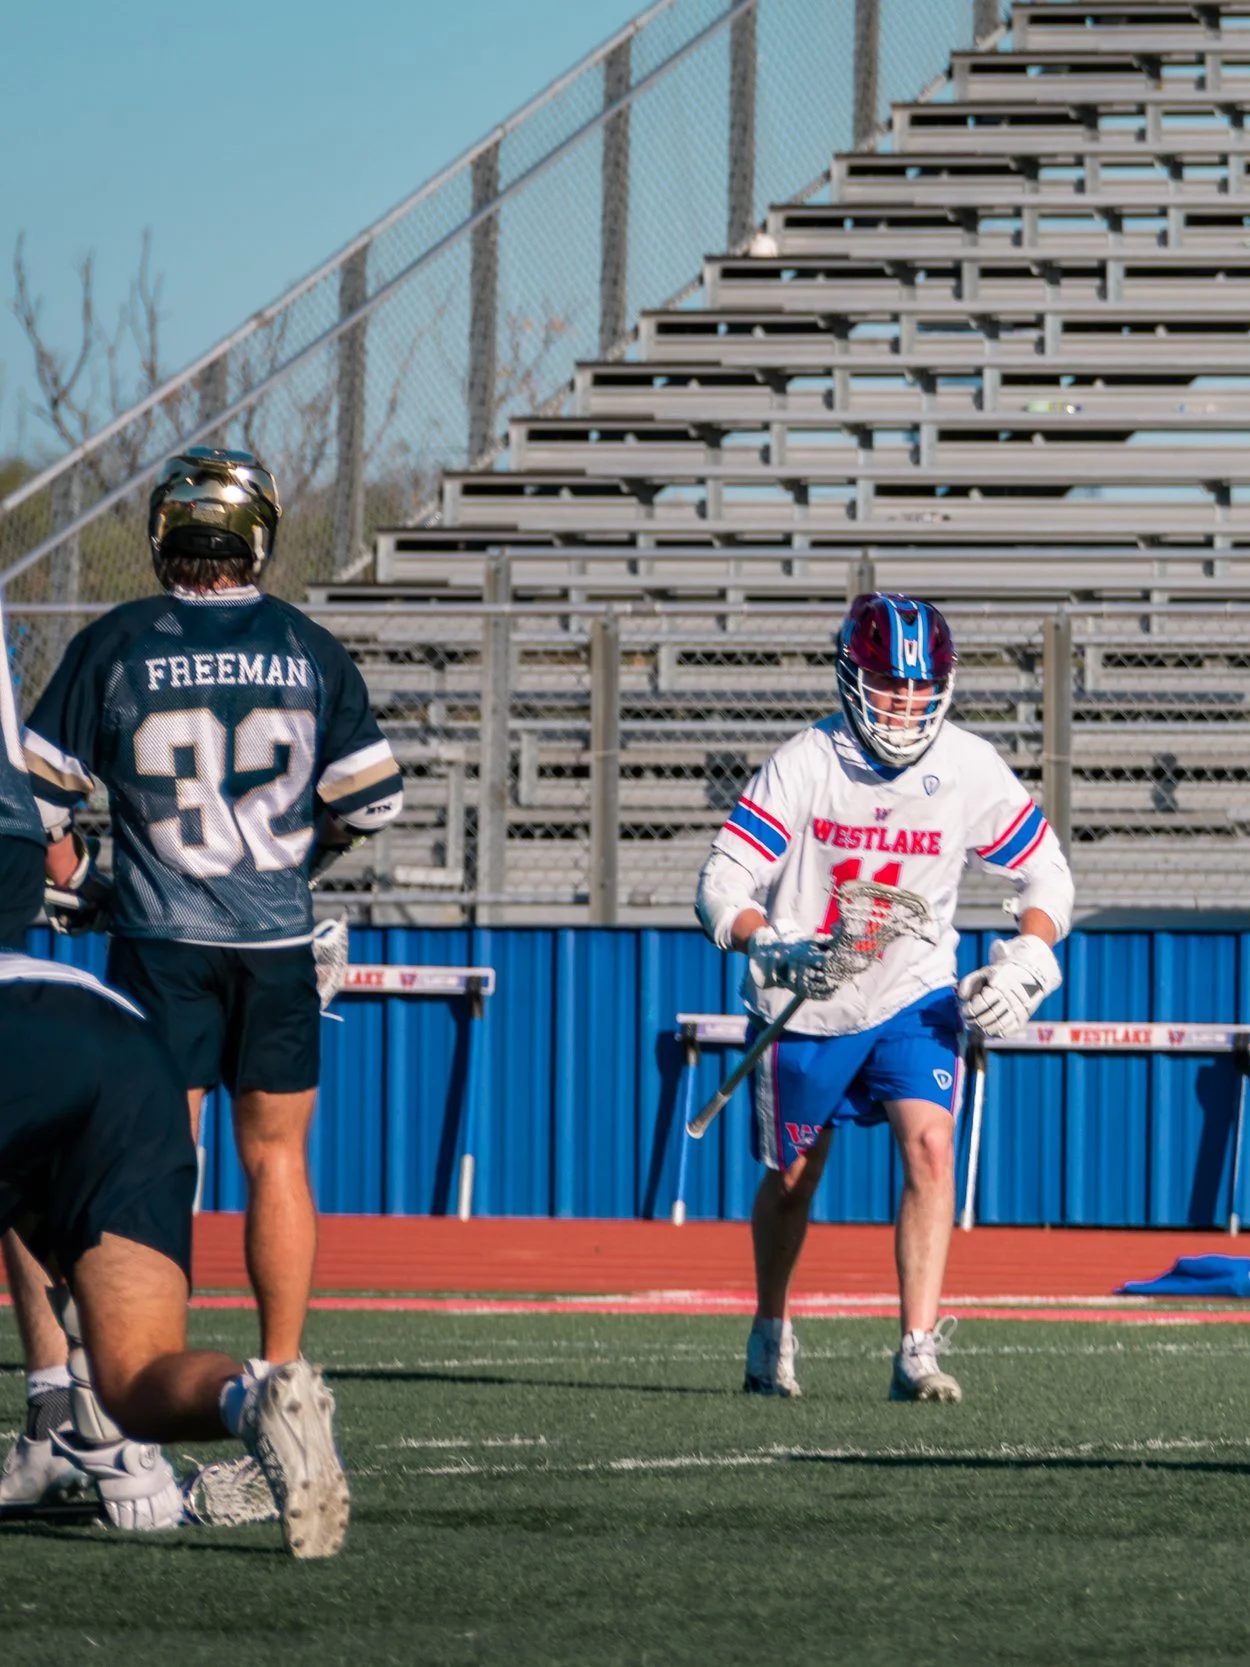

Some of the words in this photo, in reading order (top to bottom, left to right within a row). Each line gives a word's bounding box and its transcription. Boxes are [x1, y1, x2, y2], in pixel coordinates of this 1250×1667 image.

[145, 653, 309, 691] FREEMAN
[133, 707, 316, 878] 32
[813, 817, 943, 856] WESTLAKE
[1069, 1028, 1152, 1046] WESTLAKE
